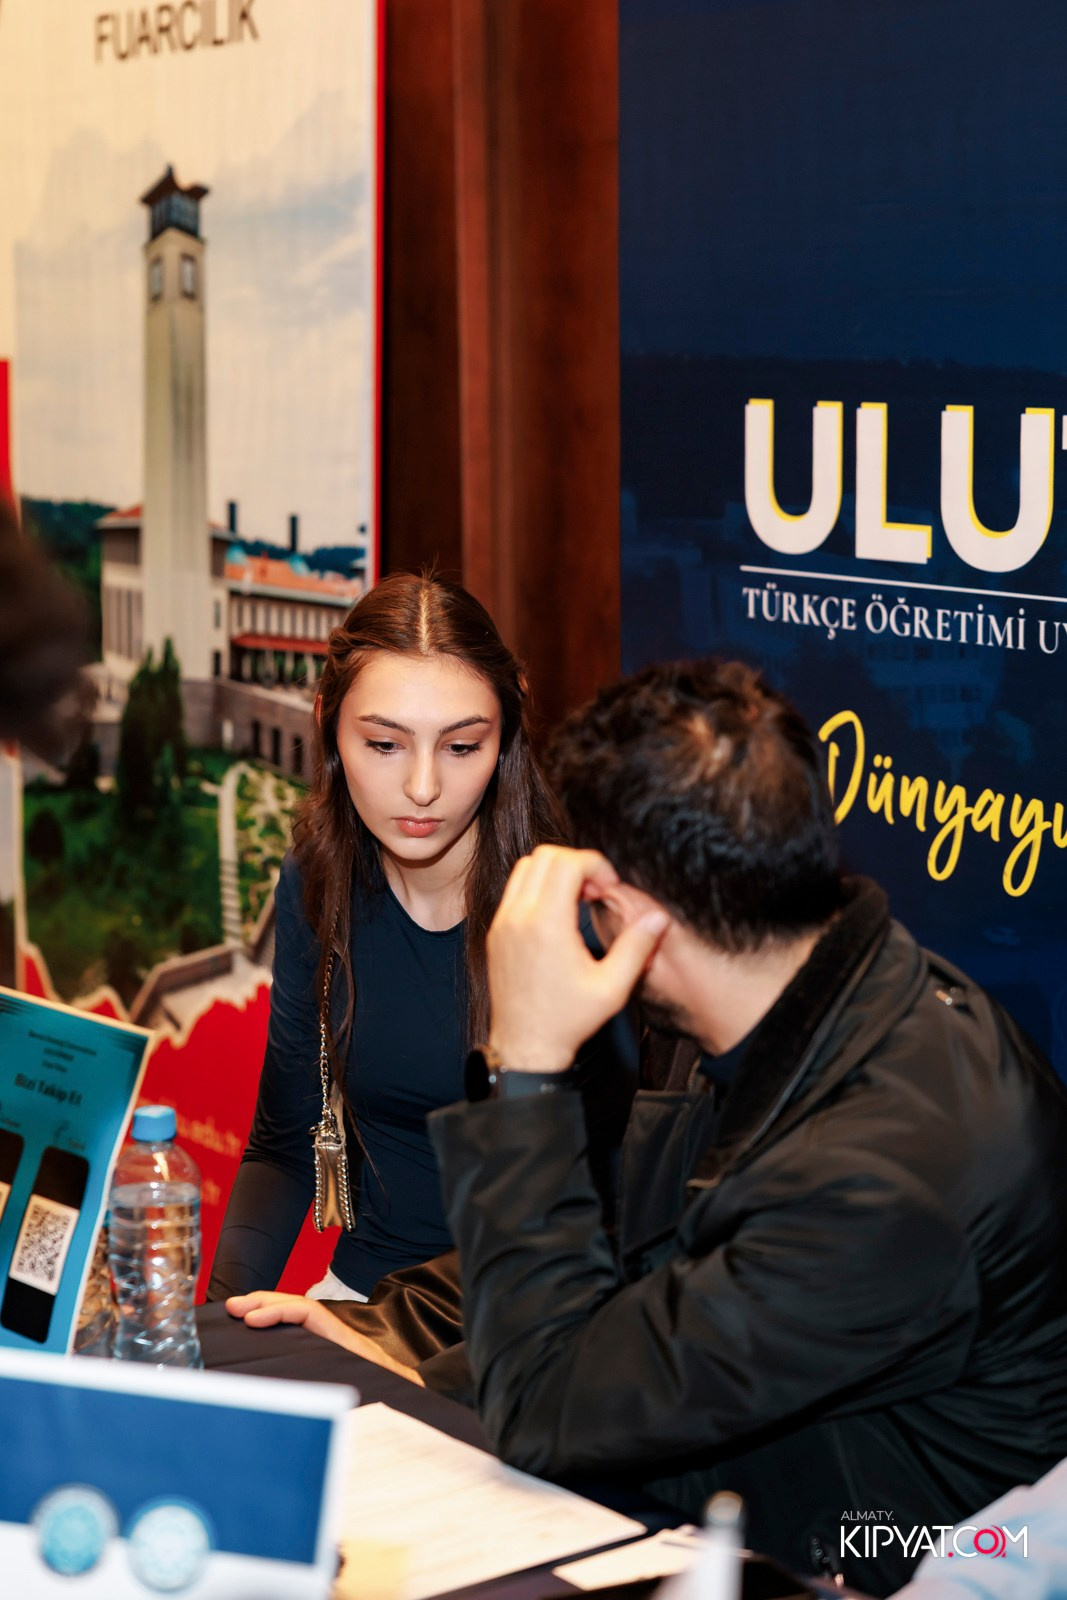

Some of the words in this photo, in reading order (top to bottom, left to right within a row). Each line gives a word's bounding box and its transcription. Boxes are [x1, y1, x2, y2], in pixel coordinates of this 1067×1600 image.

[744, 398, 1067, 573] ULU
[742, 582, 857, 640] TÜRKÇE
[865, 593, 1026, 650] ÖĞRETİMİ
[1038, 619, 1067, 655] U
